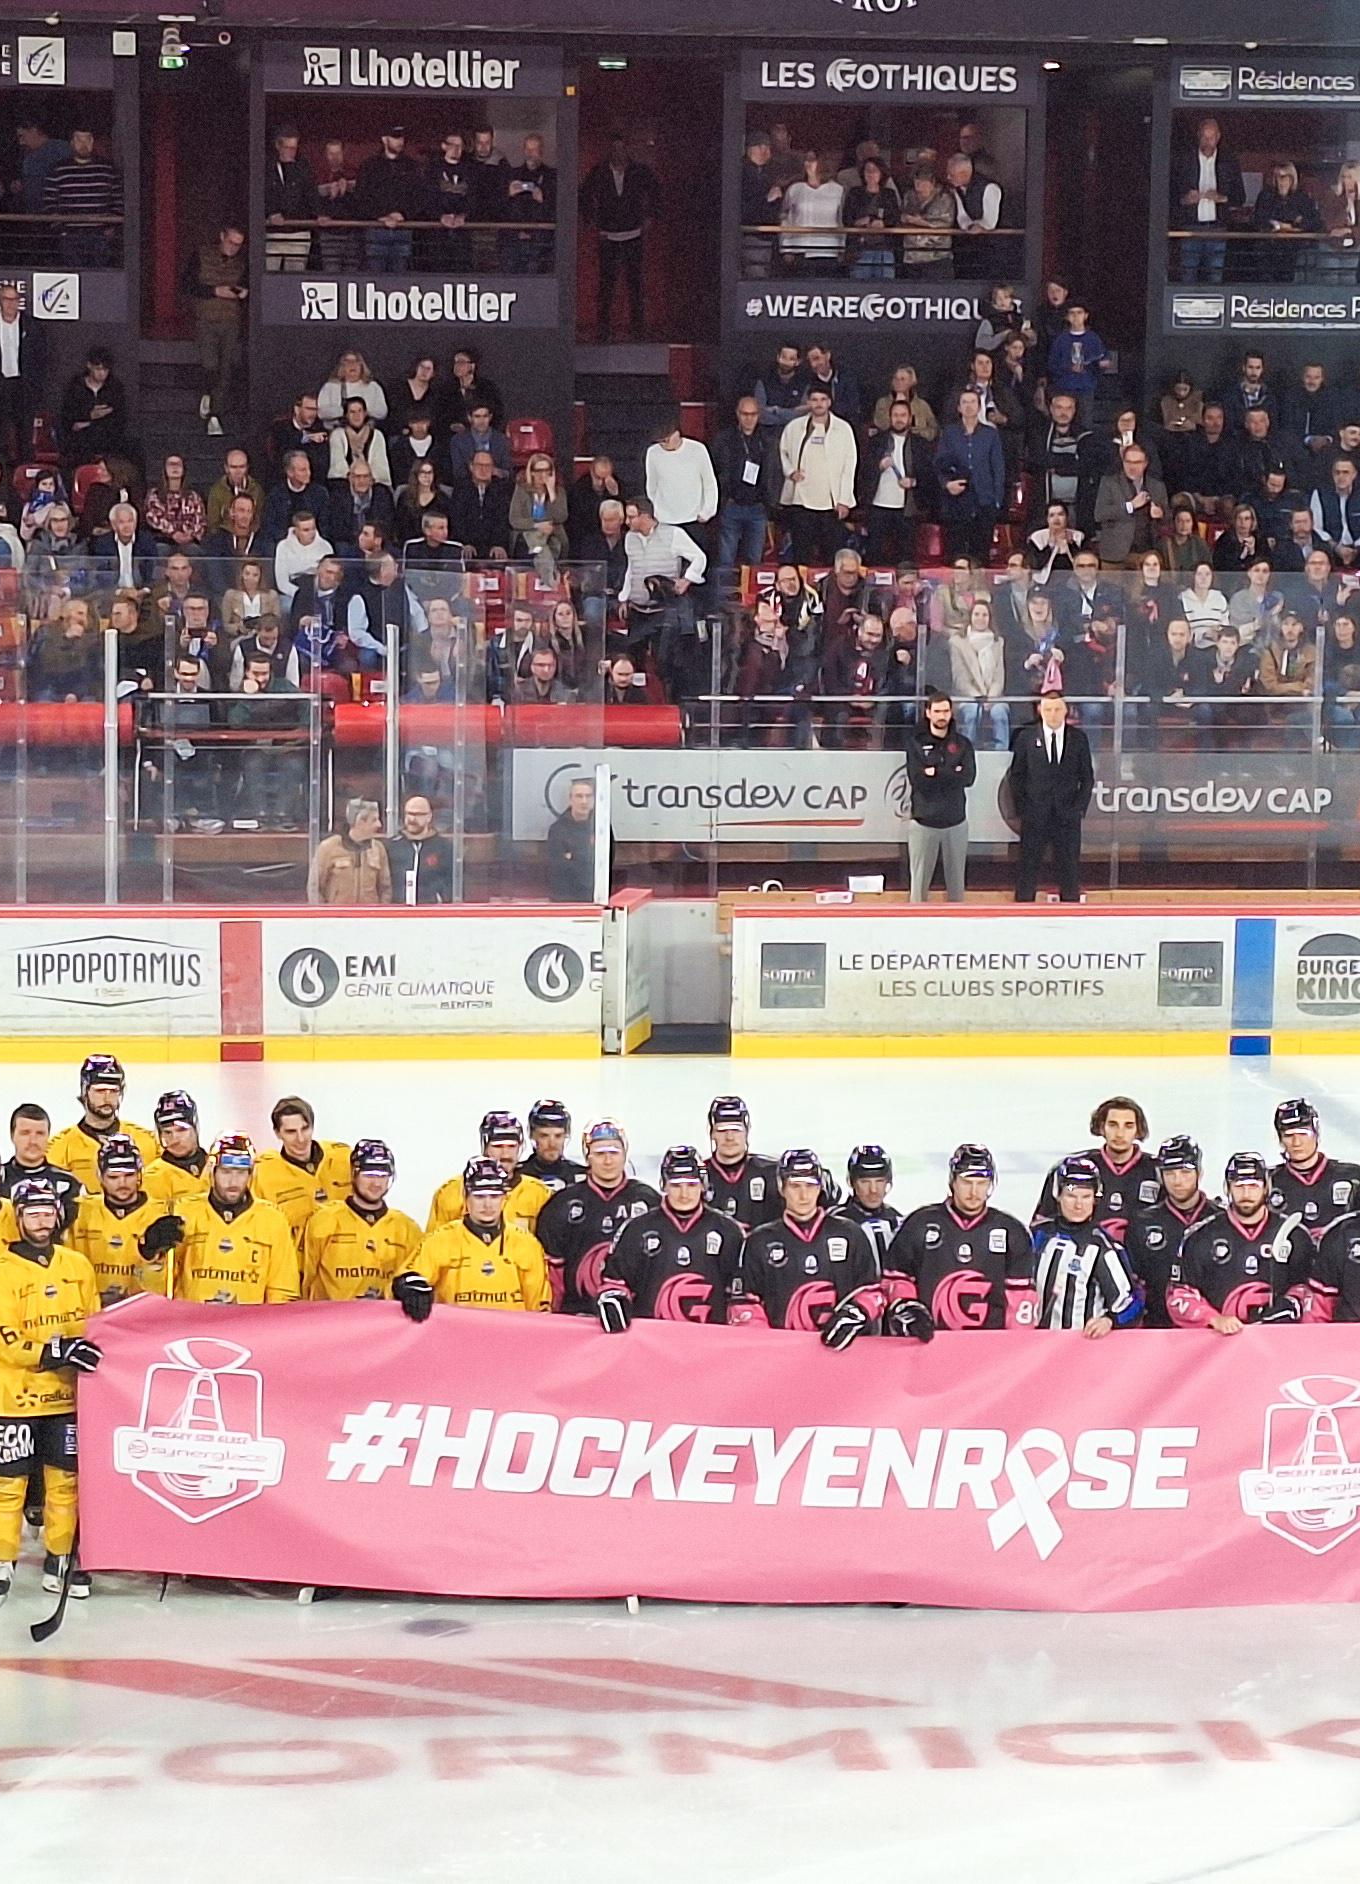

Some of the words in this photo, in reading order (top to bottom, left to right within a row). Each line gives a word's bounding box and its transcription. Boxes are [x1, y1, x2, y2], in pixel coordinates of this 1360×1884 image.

[350, 48, 520, 89] Lhotellier
[761, 61, 815, 88] LES
[827, 58, 1018, 93] GOTHIQUES
[1238, 67, 1355, 92] Résidences
[347, 282, 516, 322] Lhotellier
[1230, 295, 1346, 320] Résidences
[622, 777, 793, 809] transdev
[803, 785, 868, 810] CAP
[1092, 780, 1262, 813] transdev
[1267, 788, 1332, 813] CAP
[16, 953, 201, 989] HIPPOPOTAMUS
[344, 953, 397, 978] EMI
[840, 954, 864, 971] LE
[1037, 953, 1147, 970] SOUTIENT
[397, 980, 496, 997] CLIMATIQUE
[879, 981, 917, 998] LES
[924, 980, 995, 997] CLUBS
[1001, 979, 1105, 997] SPORTIFS
